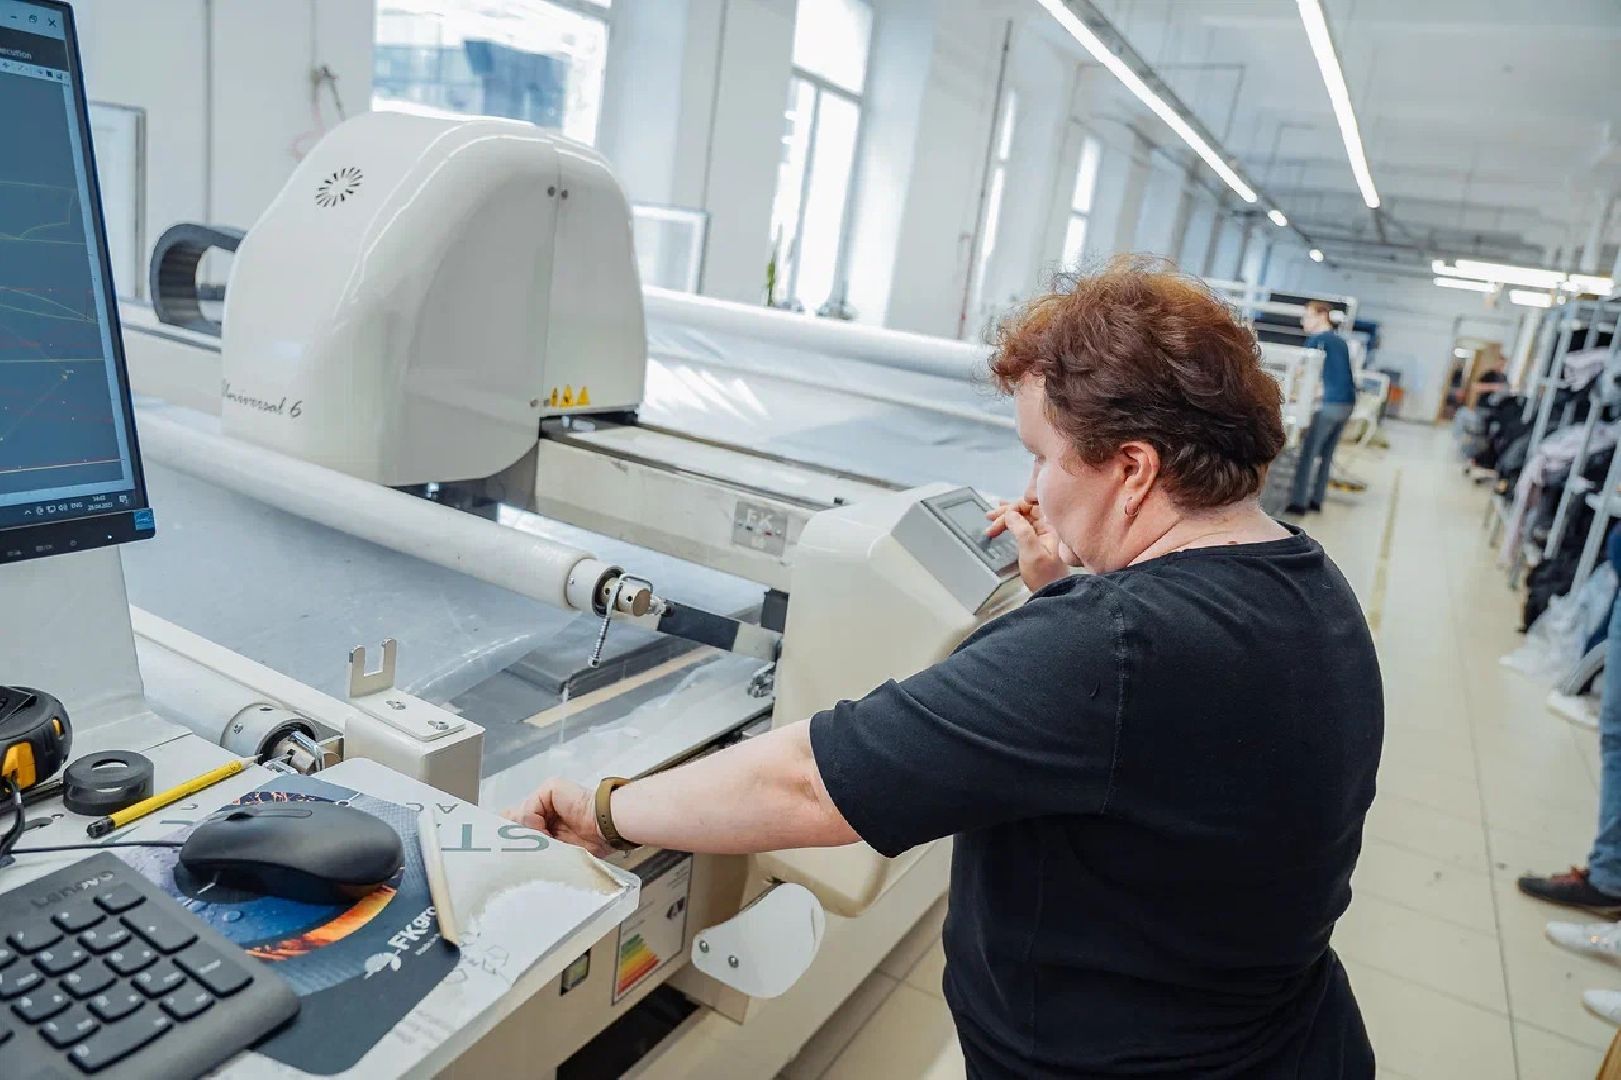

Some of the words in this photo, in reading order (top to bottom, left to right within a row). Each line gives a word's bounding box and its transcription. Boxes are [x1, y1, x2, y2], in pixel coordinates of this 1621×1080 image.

[289, 400, 303, 418] 6
[436, 823, 550, 853] ST
[387, 905, 437, 950] FKgro
